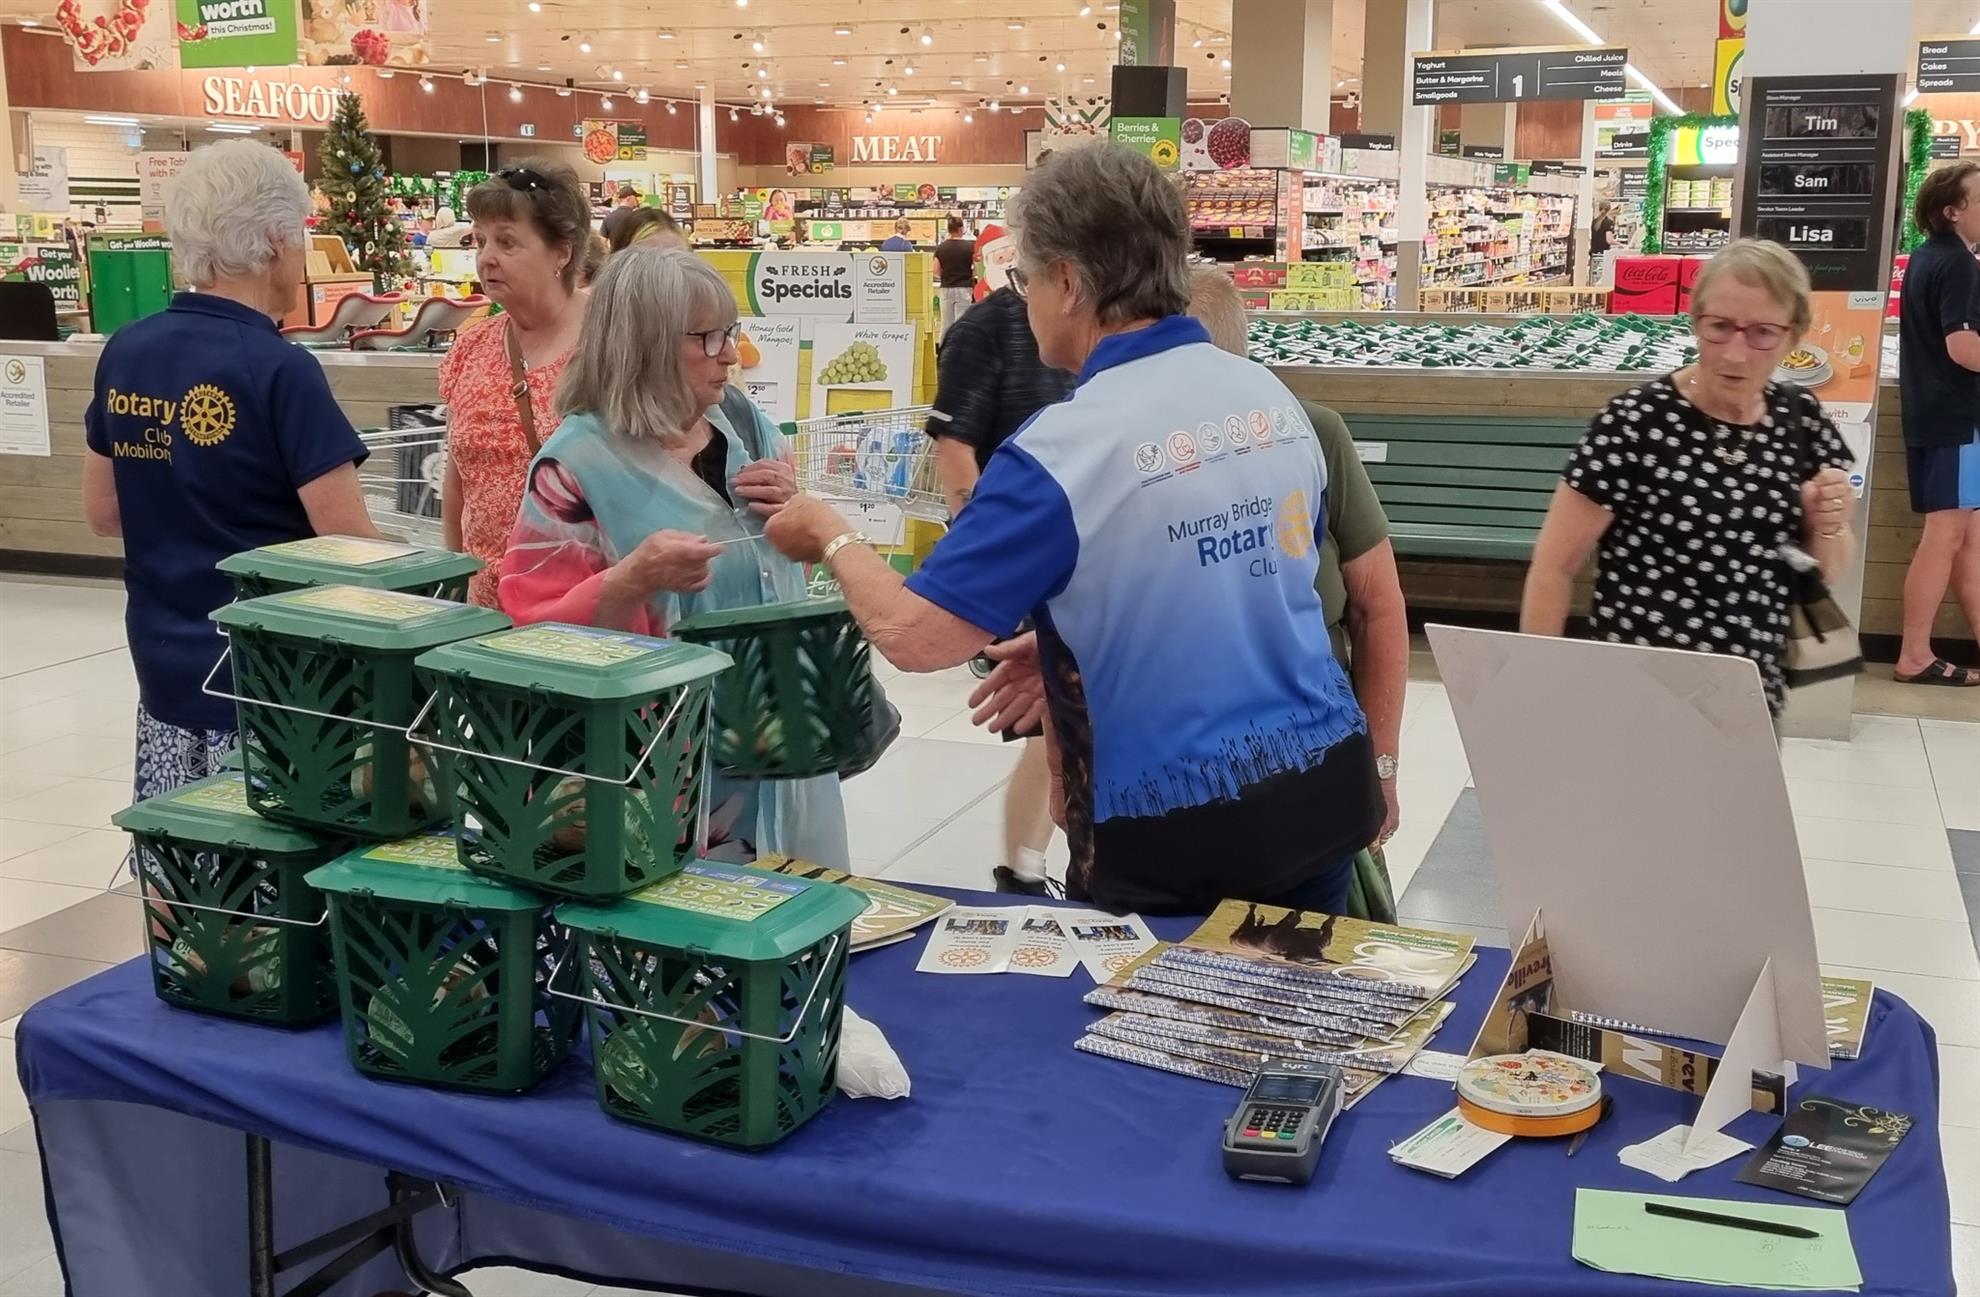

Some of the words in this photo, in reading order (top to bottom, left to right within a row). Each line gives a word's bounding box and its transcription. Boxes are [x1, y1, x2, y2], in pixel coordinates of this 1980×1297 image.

[210, 23, 226, 34] this
[227, 22, 273, 33] Christmas!
[1922, 46, 1948, 54] Bread
[1574, 55, 1602, 63] Chilled
[1603, 54, 1624, 62] Juice
[1416, 62, 1446, 70] Yoghurt
[1921, 63, 1948, 71] Cakes
[1600, 69, 1623, 77] Meals
[1416, 76, 1440, 84] Butter
[1447, 75, 1484, 85] Margarine
[1919, 79, 1954, 88] Spreads
[1512, 75, 1524, 97] 1
[1594, 85, 1623, 94] Cheese
[1415, 91, 1458, 100] Smallgoods
[1117, 122, 1149, 133] Berries
[1151, 123, 1159, 133] &
[1805, 116, 1838, 131] Tim
[1117, 134, 1157, 143] Cherries
[851, 136, 942, 163] MEAT
[1368, 142, 1392, 150] Yoghurt
[149, 157, 168, 167] Free
[150, 169, 169, 178] with
[1794, 175, 1829, 188] Sam
[1789, 226, 1834, 243] Lisa
[110, 240, 123, 250] Get
[134, 239, 160, 249] Woolies
[40, 249, 57, 258] Get
[57, 251, 73, 261] your
[27, 264, 81, 281] Woolies
[782, 265, 831, 276] FRESH
[761, 278, 852, 303] Specials
[863, 281, 896, 289] Accredited
[749, 323, 775, 336] Honey
[775, 324, 794, 333] Gold
[757, 334, 793, 347] Mangoes
[854, 330, 879, 339] White
[882, 331, 910, 342] Grapes
[0, 391, 35, 400] Accredited
[5, 399, 30, 407] Retailer
[107, 388, 177, 425] Rotary
[1167, 510, 1229, 543] Murray
